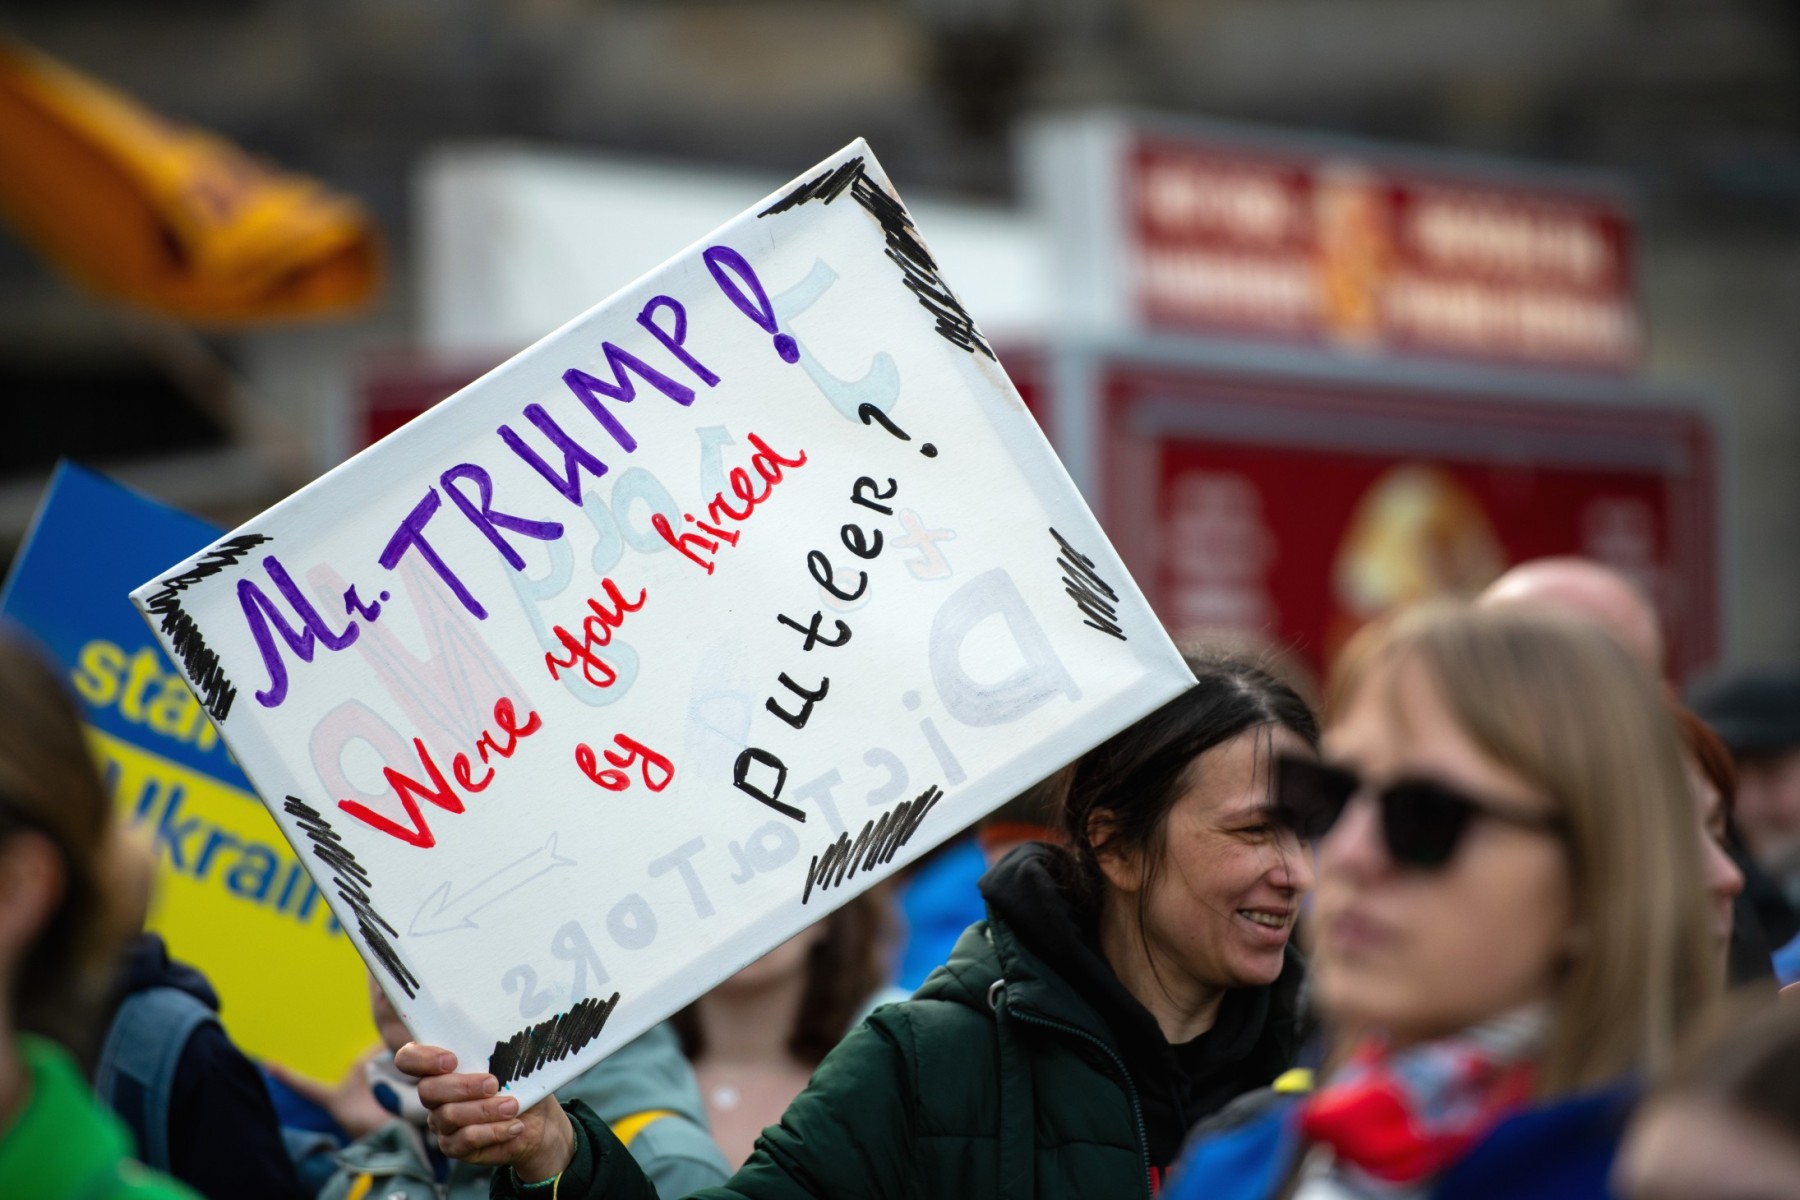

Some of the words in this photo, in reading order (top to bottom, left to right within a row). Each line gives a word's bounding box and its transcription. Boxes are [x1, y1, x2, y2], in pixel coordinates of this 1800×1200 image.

[238, 556, 389, 708] Mr.
[339, 698, 541, 848] Were
[545, 579, 647, 688] you
[651, 433, 807, 575] hired
[72, 640, 237, 764] sta
[576, 734, 675, 792] by
